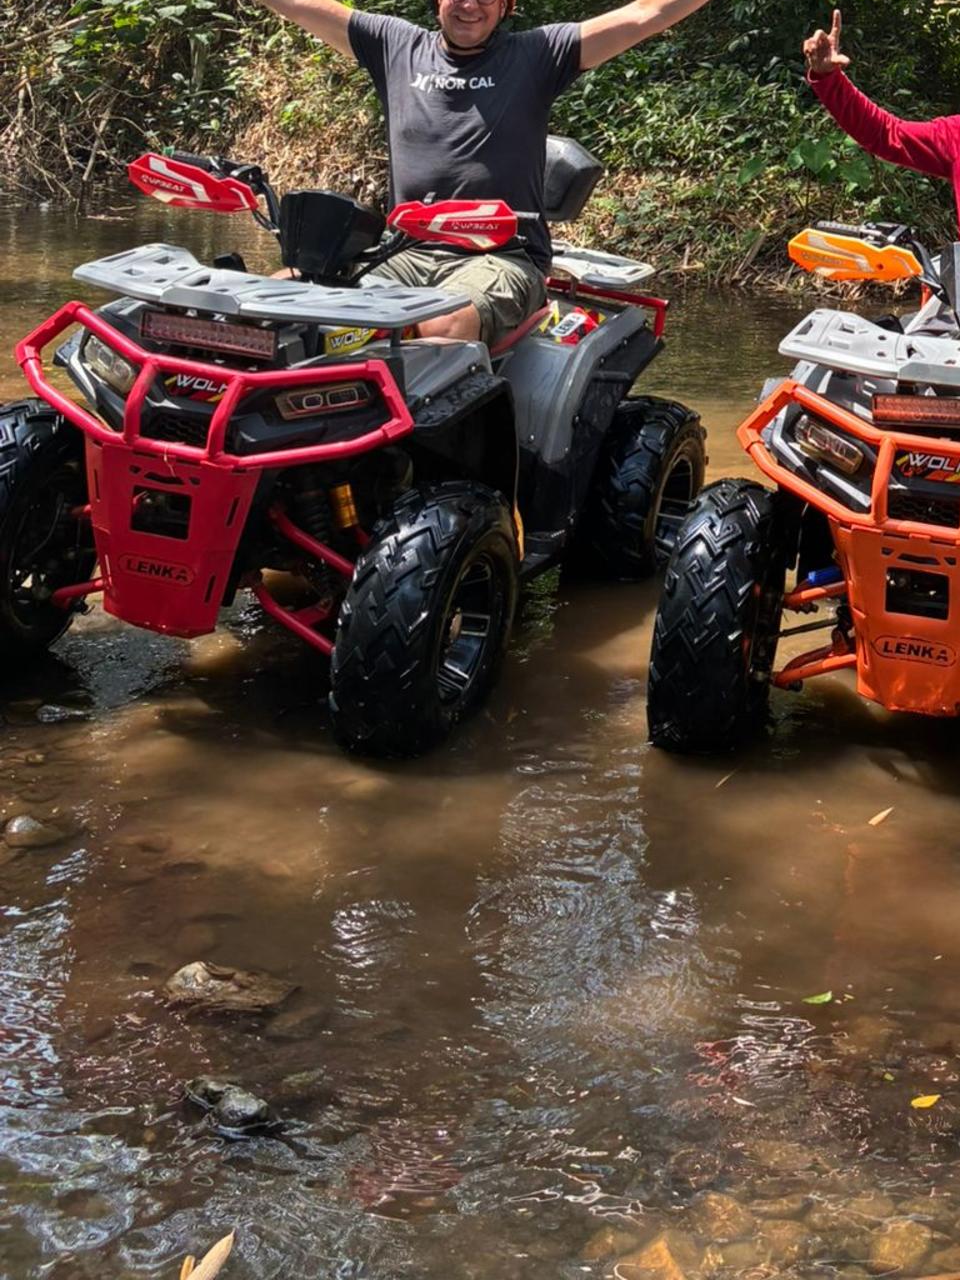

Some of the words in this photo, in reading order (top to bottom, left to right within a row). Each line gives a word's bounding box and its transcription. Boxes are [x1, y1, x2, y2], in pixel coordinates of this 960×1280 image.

[435, 77, 466, 90] NOR
[469, 76, 495, 89] CAL
[331, 327, 370, 349] WOLF
[127, 559, 188, 581] LENKA
[883, 641, 948, 661] LENKA
